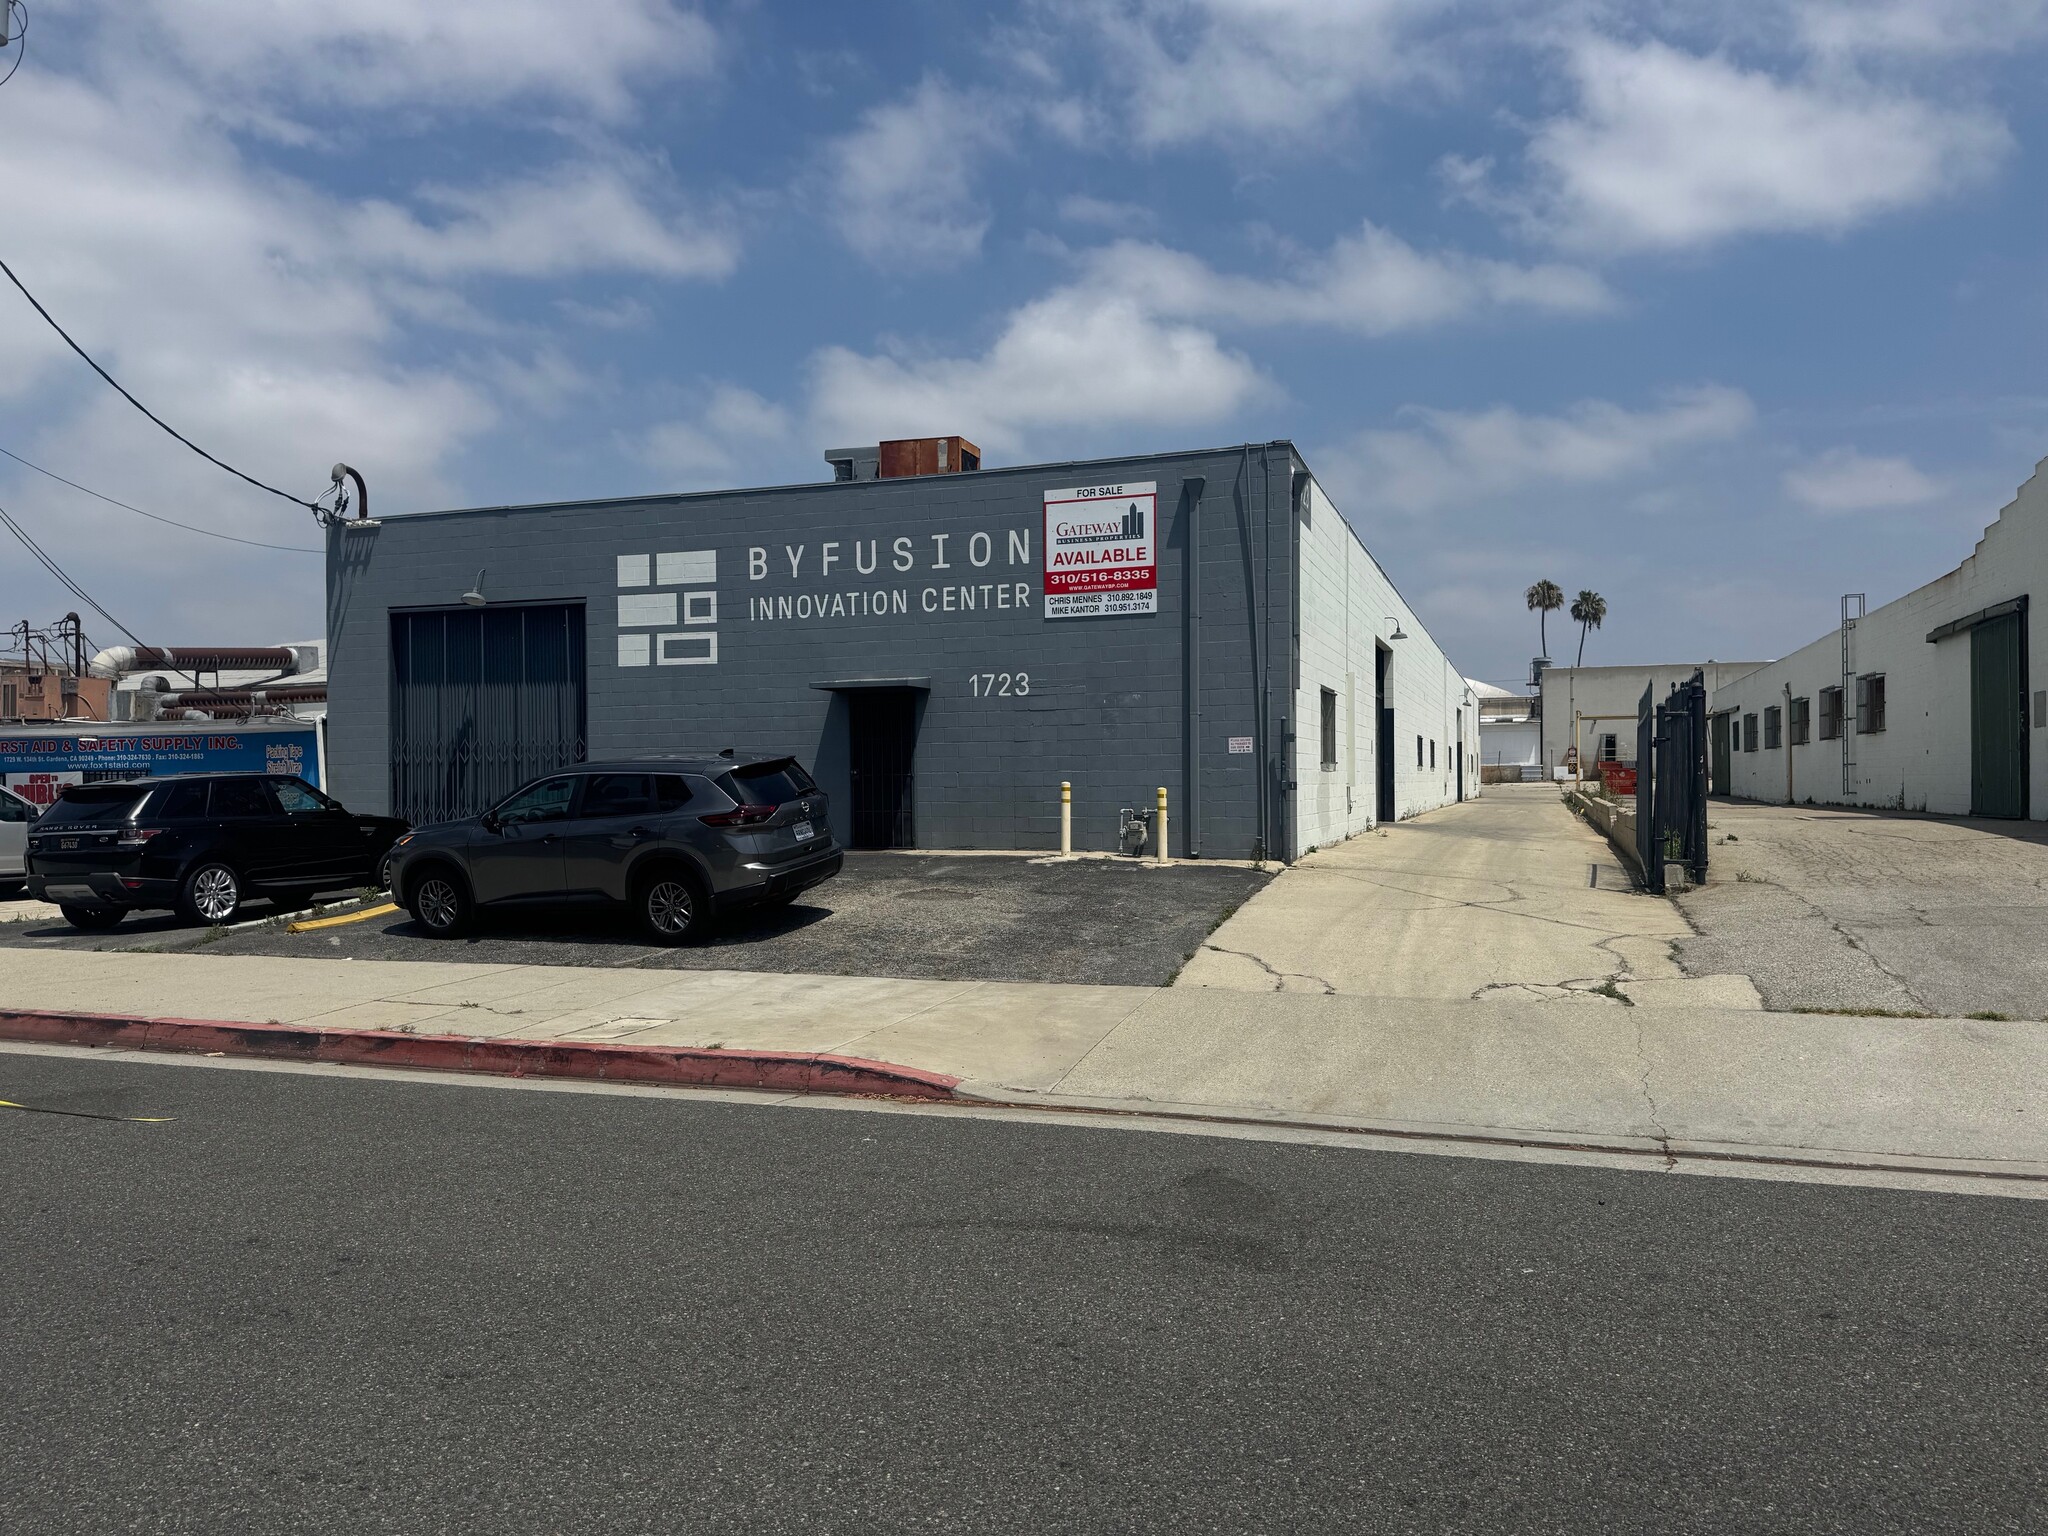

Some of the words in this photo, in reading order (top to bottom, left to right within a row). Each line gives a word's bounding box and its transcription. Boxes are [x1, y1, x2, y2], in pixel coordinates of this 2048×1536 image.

[1077, 488, 1096, 498] FOR
[1099, 486, 1123, 496] SALE
[1056, 522, 1121, 537] GATEWAY
[749, 529, 1030, 580] BYFUSION
[1053, 547, 1147, 566] AVAILABLE
[1051, 569, 1149, 585] 310/516-8335
[1069, 583, 1129, 591] WWW.GATEWAYBP.COM
[750, 589, 907, 621] INNOVATION
[922, 583, 1030, 613] CENTER
[1049, 596, 1071, 605] CHRIS
[1072, 594, 1103, 604] MENNES
[1107, 591, 1153, 602] 310.892.1849
[1051, 606, 1070, 615] MIKE
[1071, 605, 1100, 613] KANTOR
[1105, 602, 1150, 612] 310.951.3174
[969, 672, 1030, 697] 1723
[31, 740, 57, 753] AID
[62, 740, 73, 753] &
[78, 738, 138, 752] SAFETY
[141, 736, 204, 751] SUPPLY
[208, 736, 243, 750] INC.
[68, 761, 150, 769] www.fox1staid.com
[29, 774, 51, 784] OPEN
